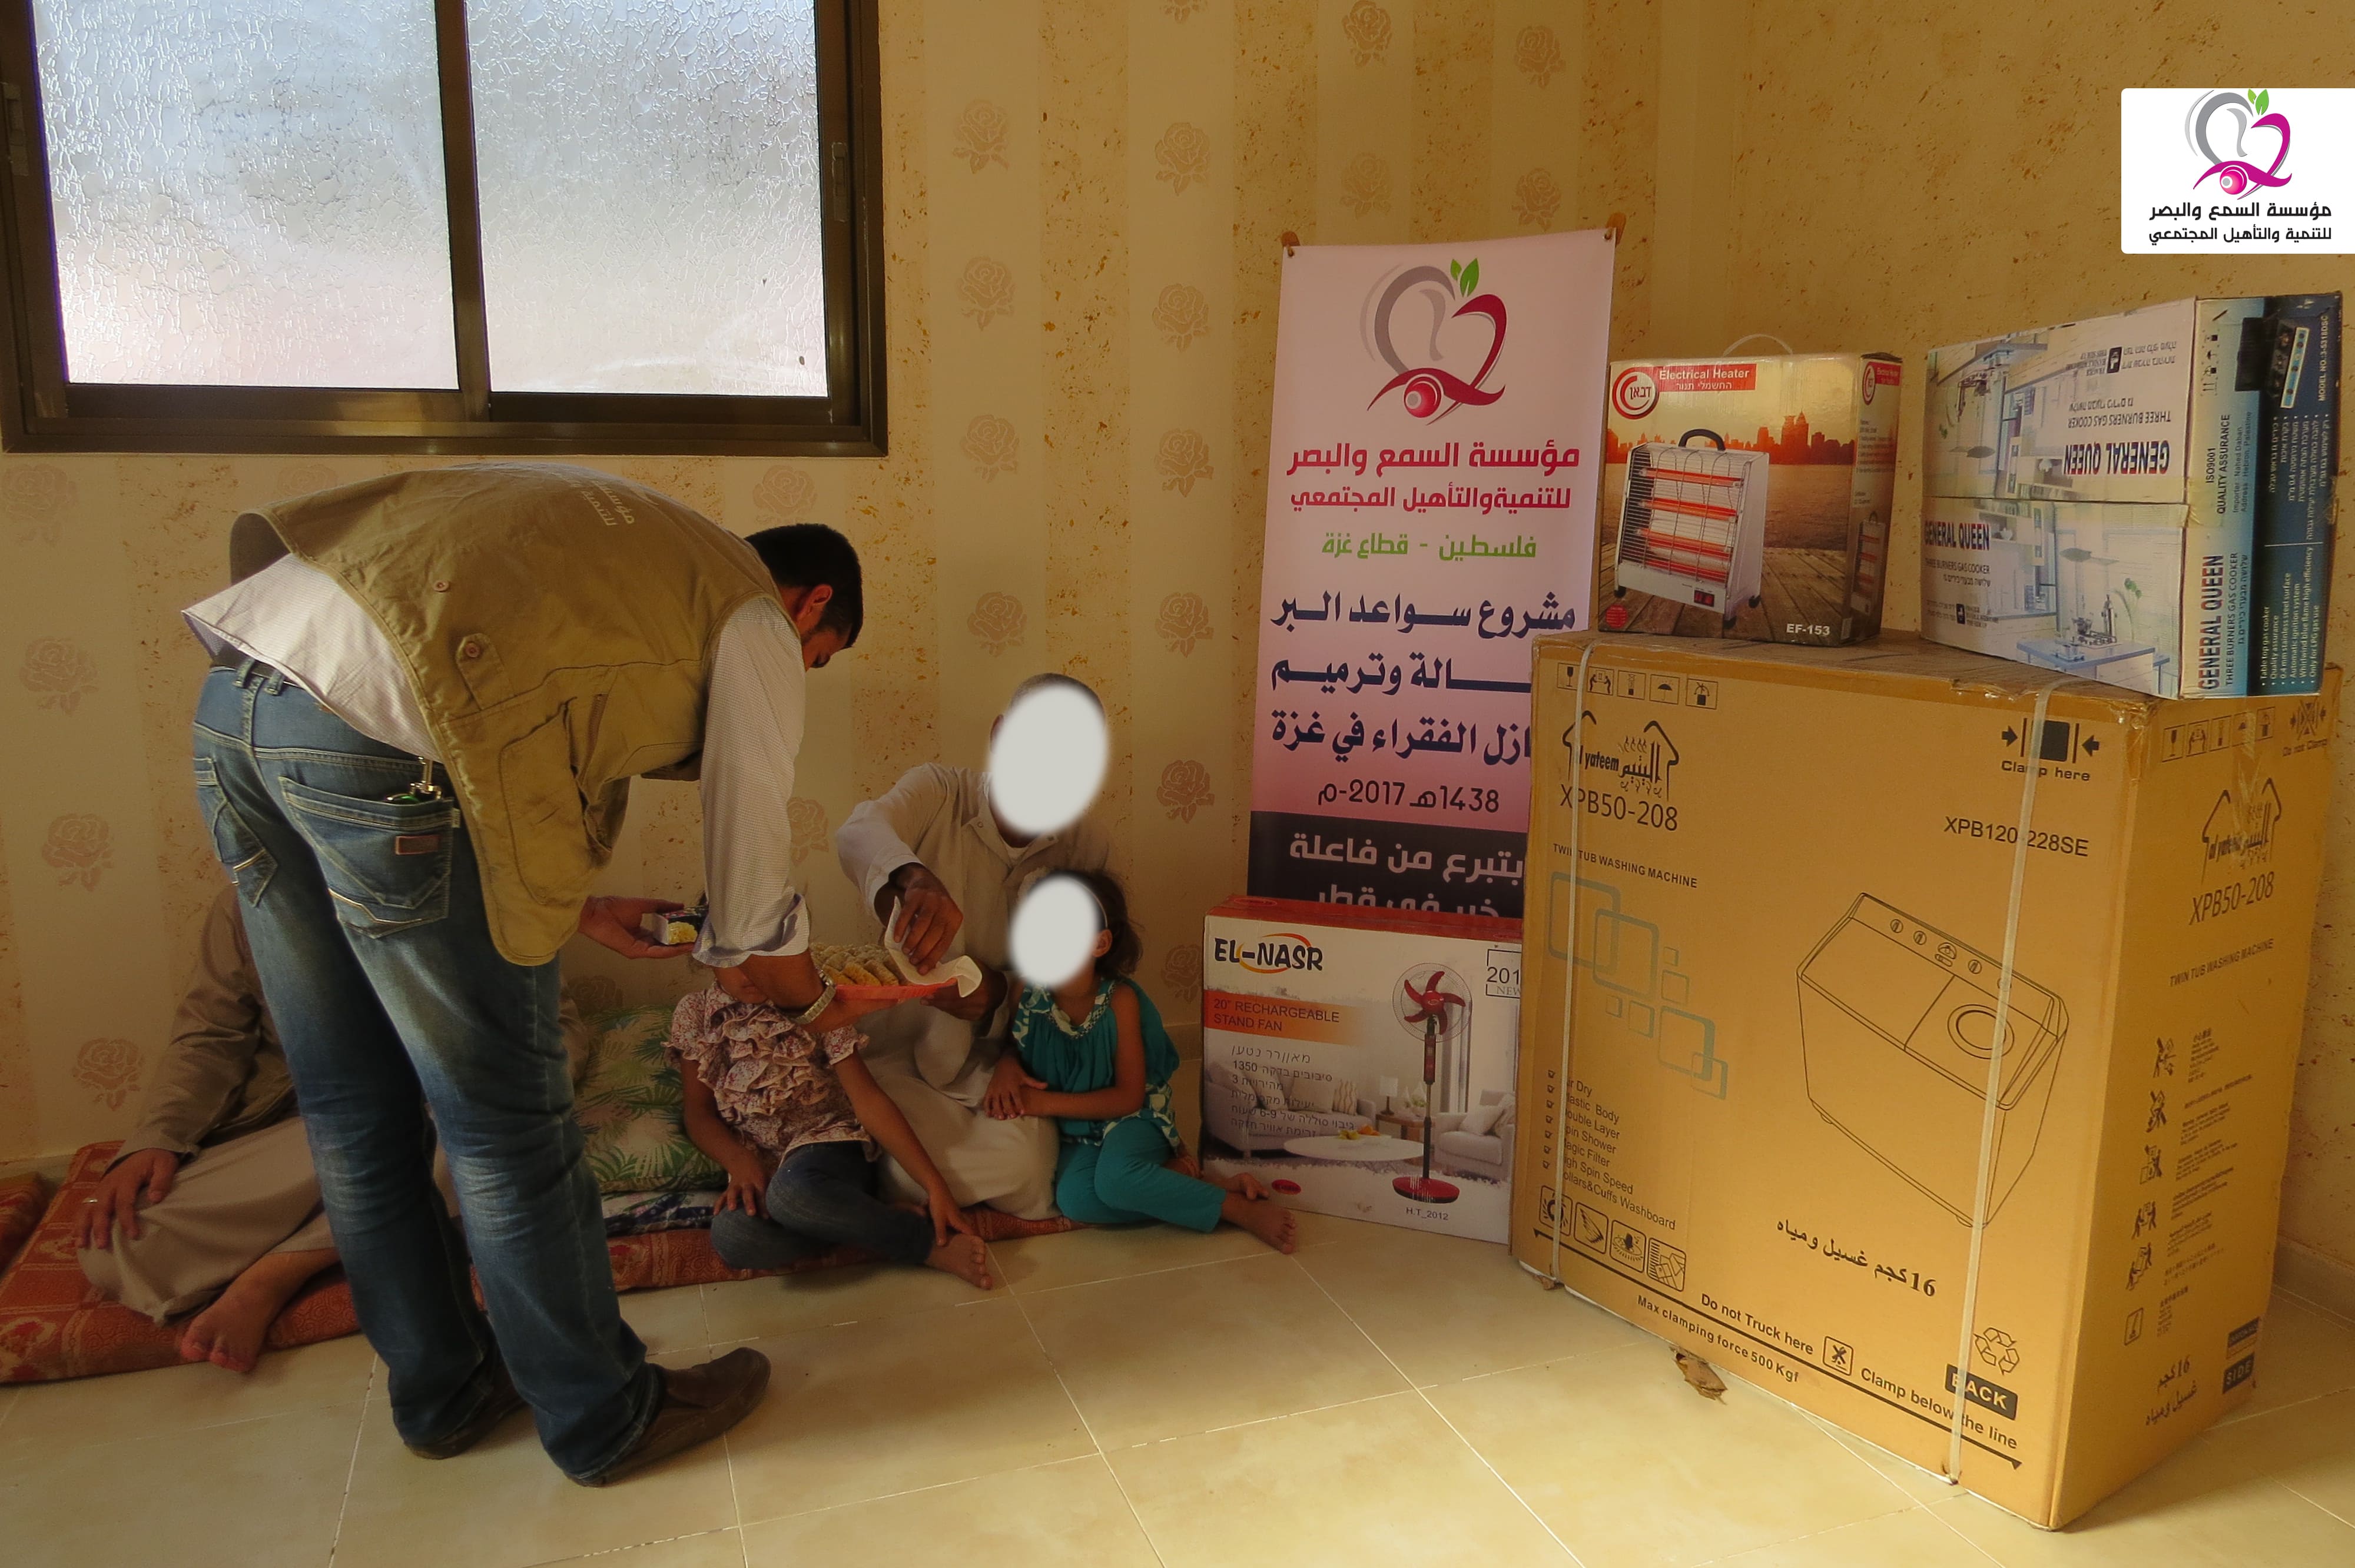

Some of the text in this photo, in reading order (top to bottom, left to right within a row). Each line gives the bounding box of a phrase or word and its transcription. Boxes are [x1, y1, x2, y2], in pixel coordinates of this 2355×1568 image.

[1659, 368, 1749, 380] Electrical Heater
[1676, 383, 1694, 391] תנור
[2067, 410, 2171, 429] THREE BURNERS GAS COOKER
[1286, 440, 1580, 478] مؤسسة السمع والبصر
[2063, 440, 2170, 476] GENERAL QUEEN
[2205, 447, 2215, 483] ISO9001
[2217, 414, 2230, 514] QUALITY ASSURANCE
[1291, 486, 1395, 513] المجتمعي
[1322, 532, 1353, 558] غزة
[1356, 532, 1409, 559] قطاع
[1439, 534, 1537, 561] فلسطين
[1958, 522, 1990, 551] QUEEN
[2303, 547, 2313, 582] efficiency
[2283, 572, 2291, 599] surface
[2303, 583, 2311, 600] high
[1478, 592, 1576, 639] مشروع
[1786, 623, 1830, 636] EF-153
[2198, 555, 2224, 690] GENERAL QUEEN
[2225, 553, 2238, 686] THREE BURNERS GAS COOKER
[2291, 610, 2300, 640] ignition
[2281, 619, 2290, 652] stainless
[1410, 652, 1531, 693] الة
[2270, 653, 2278, 679] Quality
[2281, 653, 2287, 666] mm
[2308, 660, 2318, 677] Only
[1271, 709, 1531, 765] ازل الفقراء في غزة
[2002, 760, 2091, 782] Clap here
[1560, 784, 1677, 832] XPB50-208
[1289, 832, 1378, 866] فاعلة
[1943, 816, 2089, 857] XPB120228SE
[1388, 843, 1432, 873] من
[1553, 843, 1698, 888] TWI TUB WASHING MACHINE
[2189, 871, 2275, 926] XPB50-208
[1214, 937, 1324, 971] EL-NASR
[2207, 951, 2241, 973] WASHING
[2241, 938, 2274, 959] MACHINE
[1487, 966, 1520, 985] 201
[1213, 1014, 1282, 1031] STAND FAN
[1235, 1001, 1339, 1022] RECHARGEABLE
[1233, 1060, 1332, 1082] סיבובים בדקה 1350
[1576, 1080, 1593, 1098] Dry
[1260, 1109, 1277, 1118] 6-9
[1280, 1111, 1295, 1121] של
[1567, 1092, 1620, 1125] lastic Body
[1565, 1125, 1617, 1155] pin Shower
[1594, 1119, 1620, 1140] Layer
[1564, 1138, 1611, 1168] agic Filter
[1564, 1156, 1634, 1195] igh Spin Speed
[1406, 1207, 1449, 1220] H.T_2012
[1563, 1171, 1677, 1230] ollars&Cuffs Washboard
[1776, 1218, 1819, 1250] ومياه
[1822, 1238, 1868, 1268] غسيل
[1637, 1295, 1800, 1383] Max clamping force 500 Kgf
[1701, 1293, 1814, 1355] Do not Truck here
[2226, 1360, 2251, 1386] SIDE
[1860, 1367, 2018, 1450] Clamp below the line
